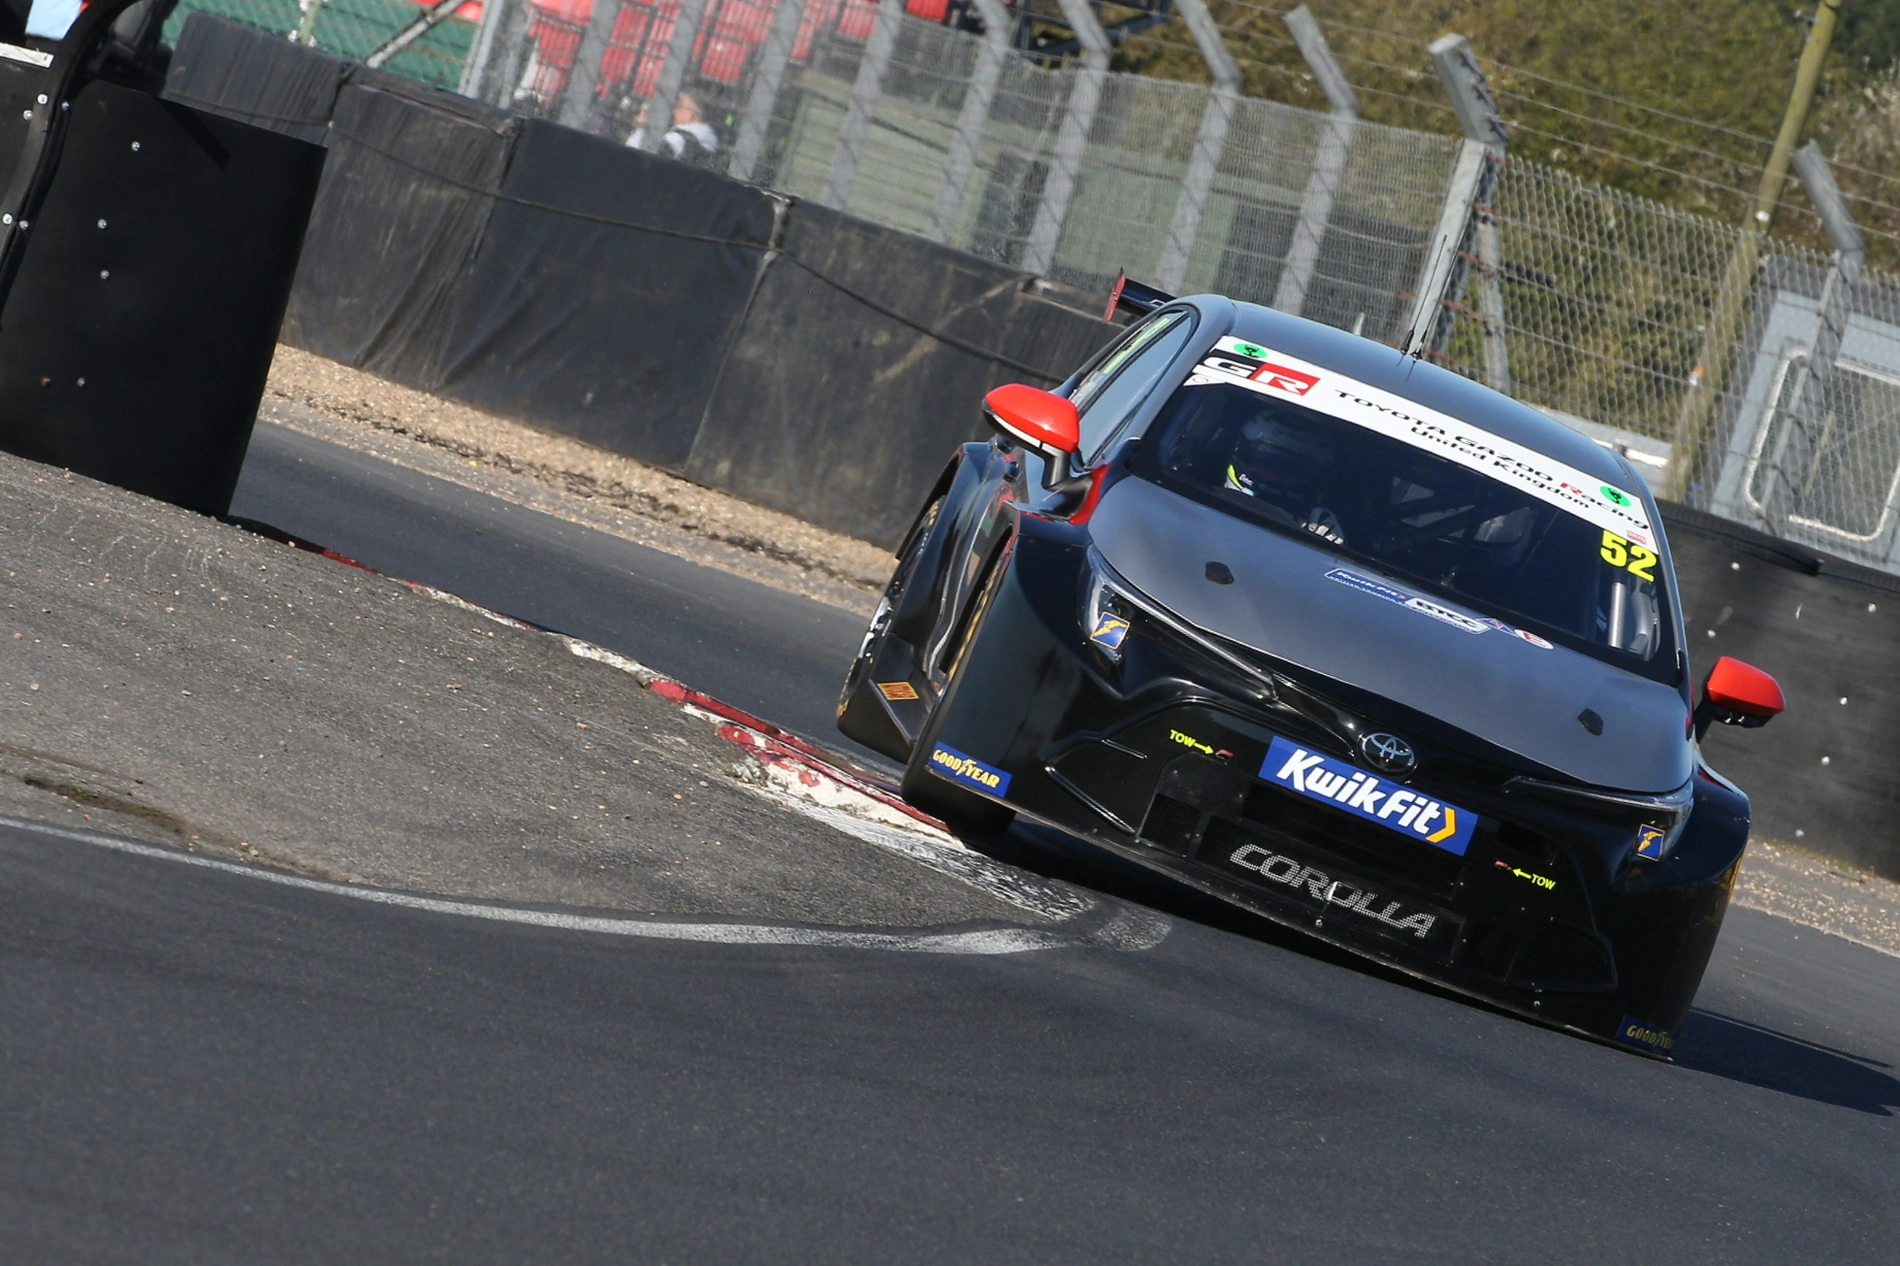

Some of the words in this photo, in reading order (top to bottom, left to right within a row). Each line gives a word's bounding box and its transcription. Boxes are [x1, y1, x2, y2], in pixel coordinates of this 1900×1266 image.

[1203, 356, 1310, 396] GR
[1334, 389, 1446, 435] TOYOTA
[1455, 435, 1554, 482] GAZOO
[1560, 482, 1650, 530] Racing
[1410, 426, 1487, 461] United
[1493, 460, 1590, 509] Kingdom
[1600, 530, 1658, 583] 52
[1169, 729, 1196, 749] TOW
[932, 749, 1001, 789] GOODYEAR
[1229, 843, 1437, 939] COROLLA
[1531, 873, 1556, 891] TOW
